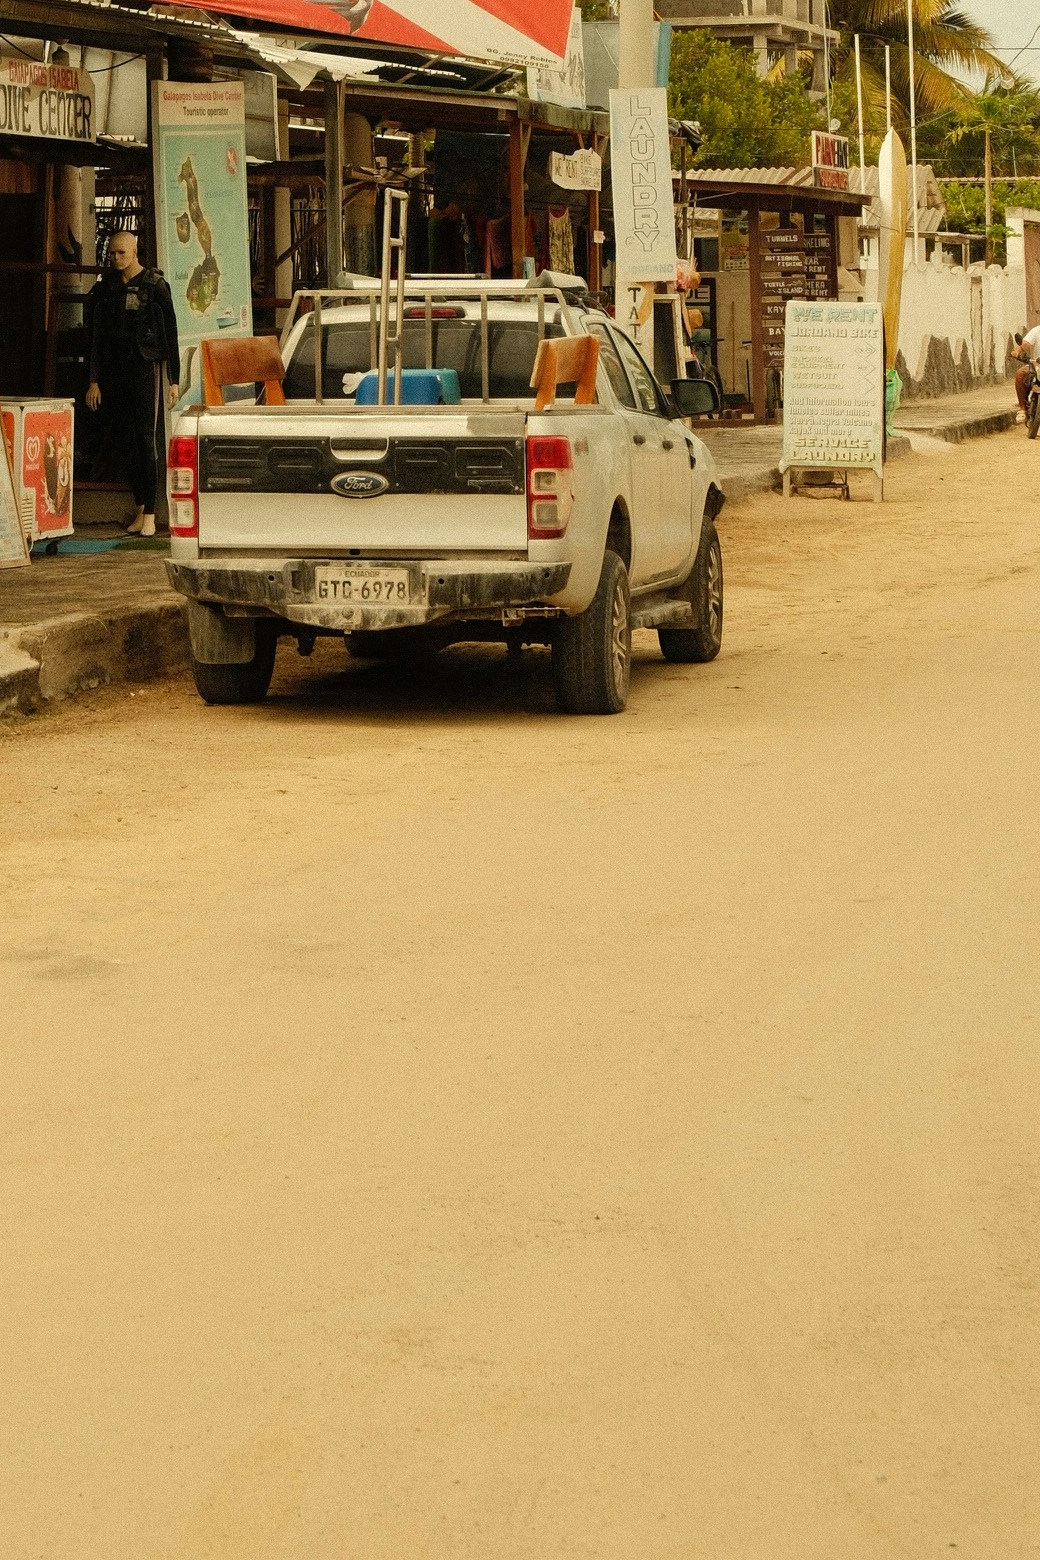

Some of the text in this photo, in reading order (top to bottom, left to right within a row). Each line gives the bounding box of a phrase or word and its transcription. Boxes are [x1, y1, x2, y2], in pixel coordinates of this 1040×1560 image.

[163, 91, 242, 103] Galapagos Isabela Dive Center
[183, 106, 229, 118] Touristic operator
[628, 95, 660, 252] LAUNDRY
[765, 235, 799, 243] TUNNELS
[778, 286, 804, 294] ISLAND
[794, 307, 879, 325] WE RENT
[791, 327, 879, 339] JORDANO BIKE
[814, 427, 830, 436] and
[830, 428, 853, 437] more
[794, 437, 872, 450] SERVICE
[790, 450, 877, 463] LAUNDRY
[343, 476, 374, 491] Ford
[344, 571, 380, 579] ECUADOR
[318, 580, 407, 600] GTC-6978
